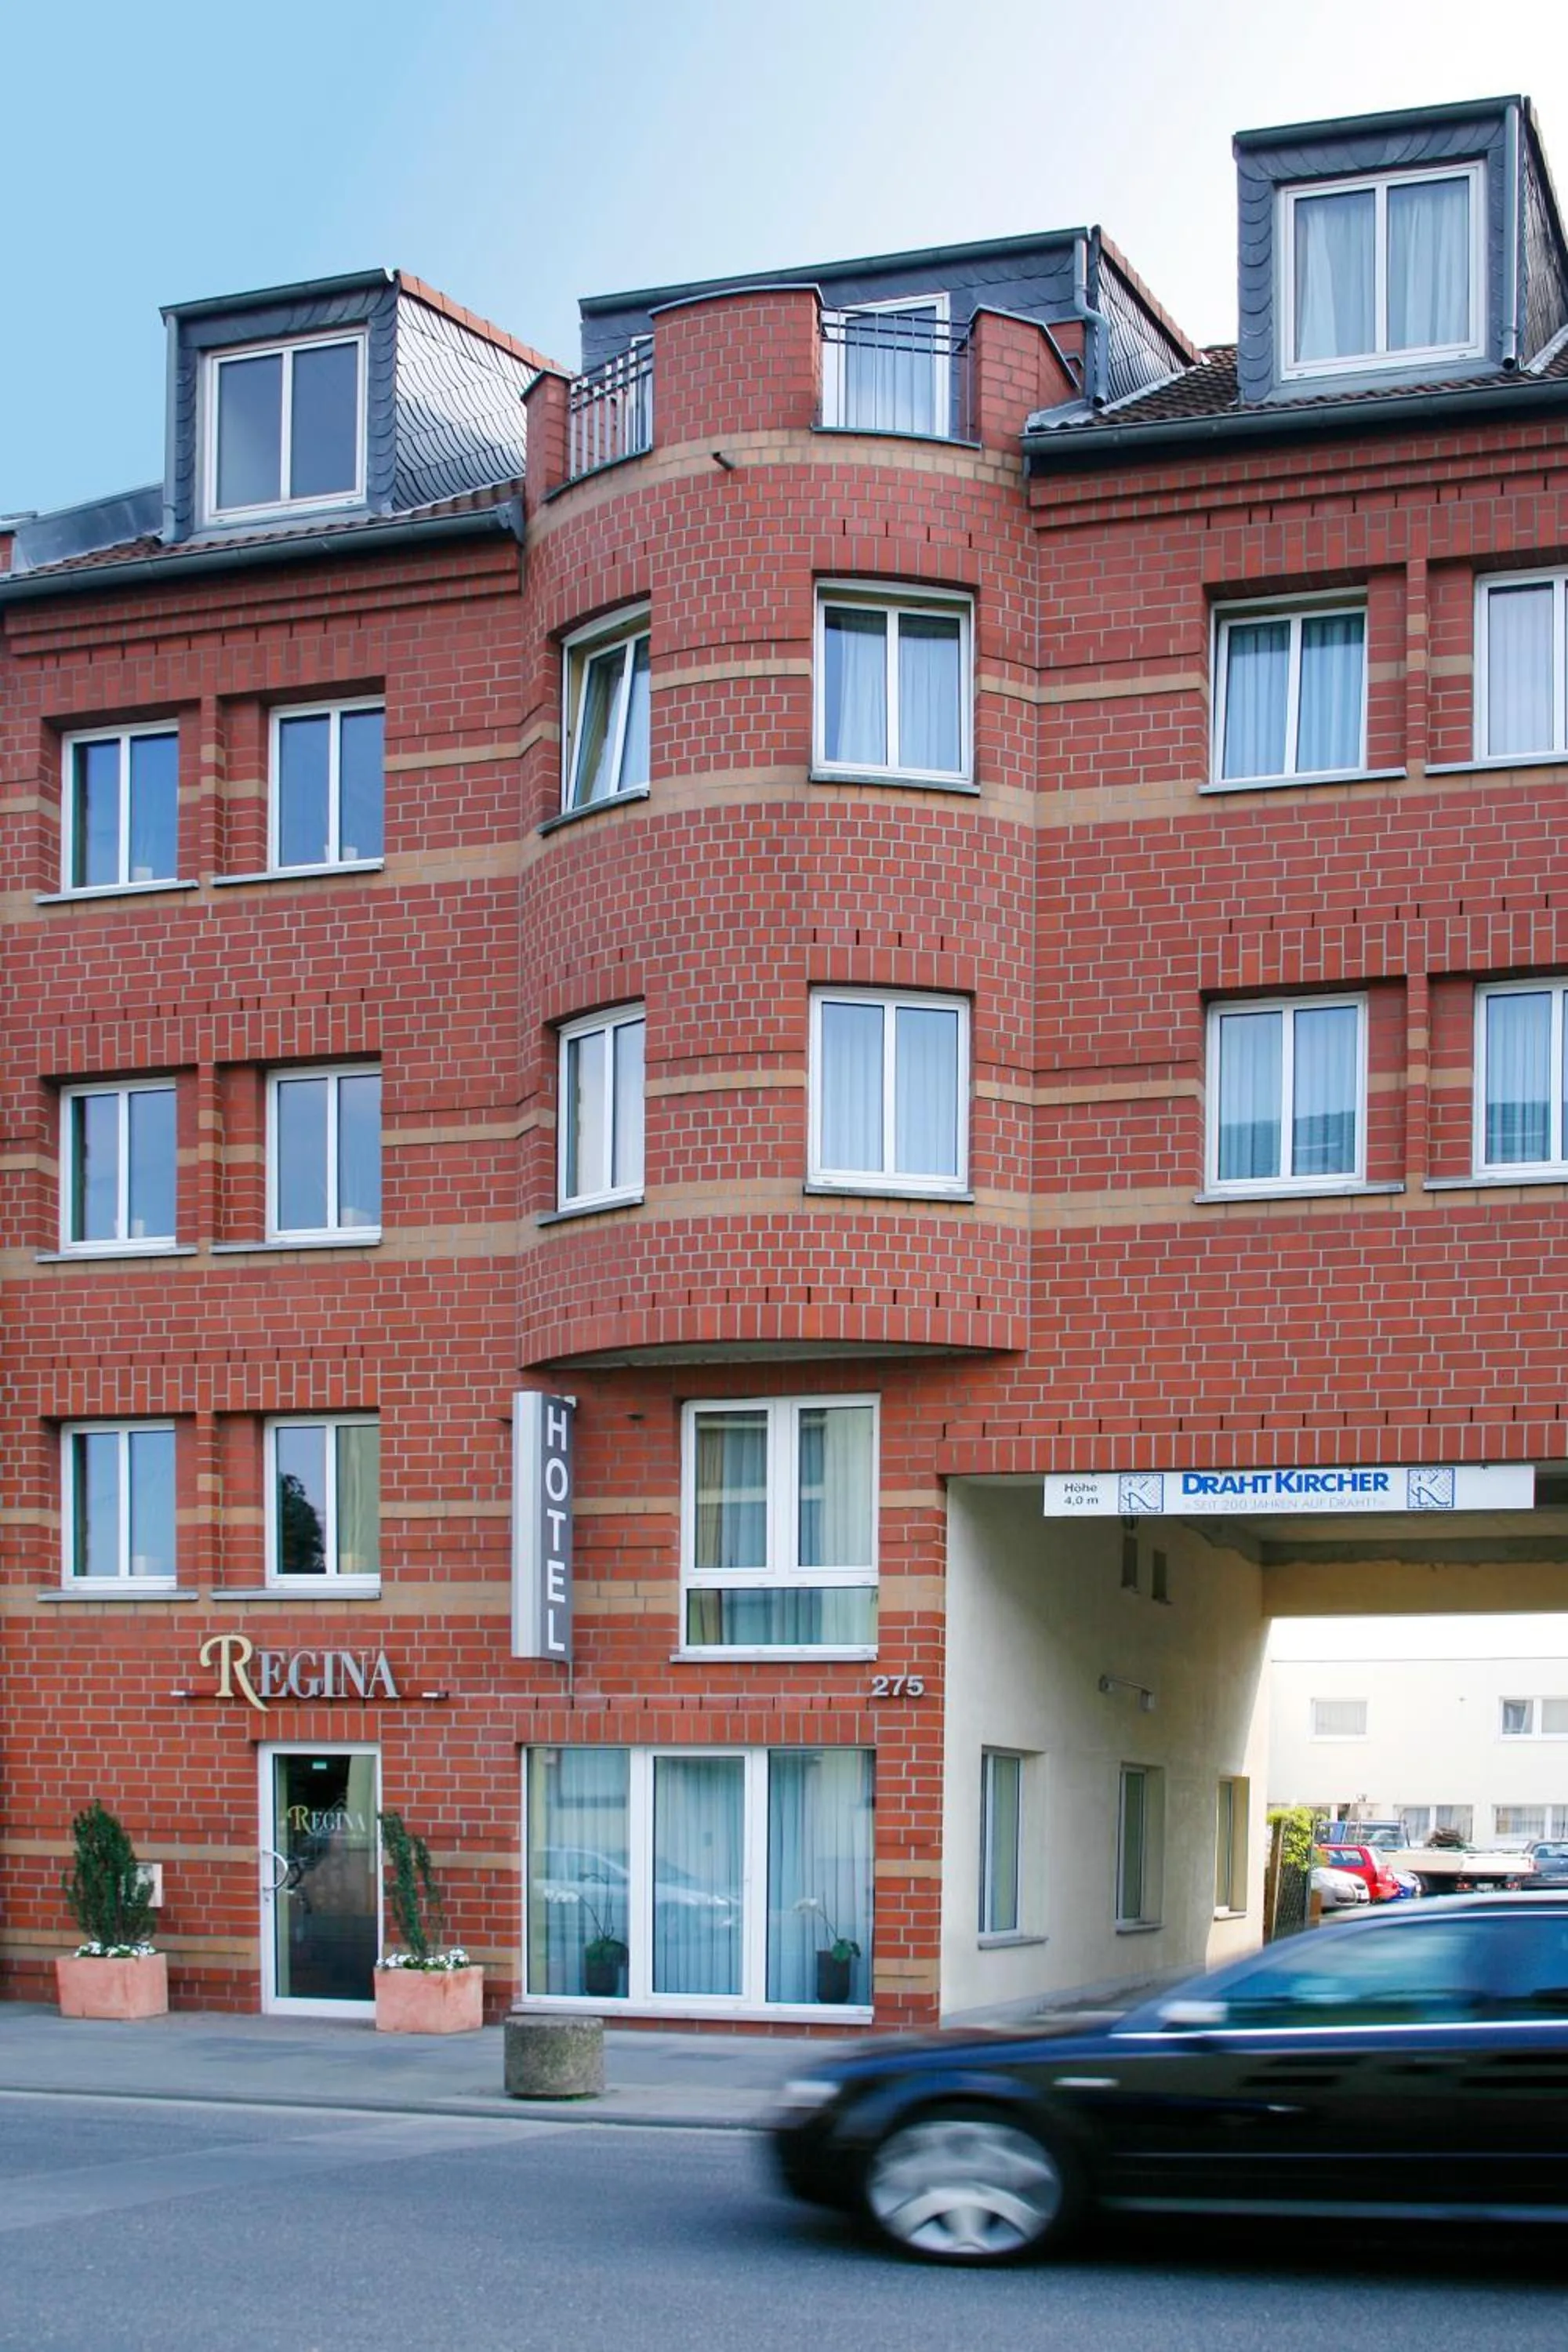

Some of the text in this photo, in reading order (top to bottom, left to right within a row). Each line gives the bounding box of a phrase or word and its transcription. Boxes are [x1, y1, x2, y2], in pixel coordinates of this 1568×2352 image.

[1064, 1483, 1098, 1494] Höhe
[1064, 1495, 1098, 1505] 4,0 m
[1221, 1498, 1247, 1511] 200
[546, 1405, 568, 1652] HOTEL
[199, 1635, 401, 1711] REGINA
[872, 1675, 924, 1697] 275
